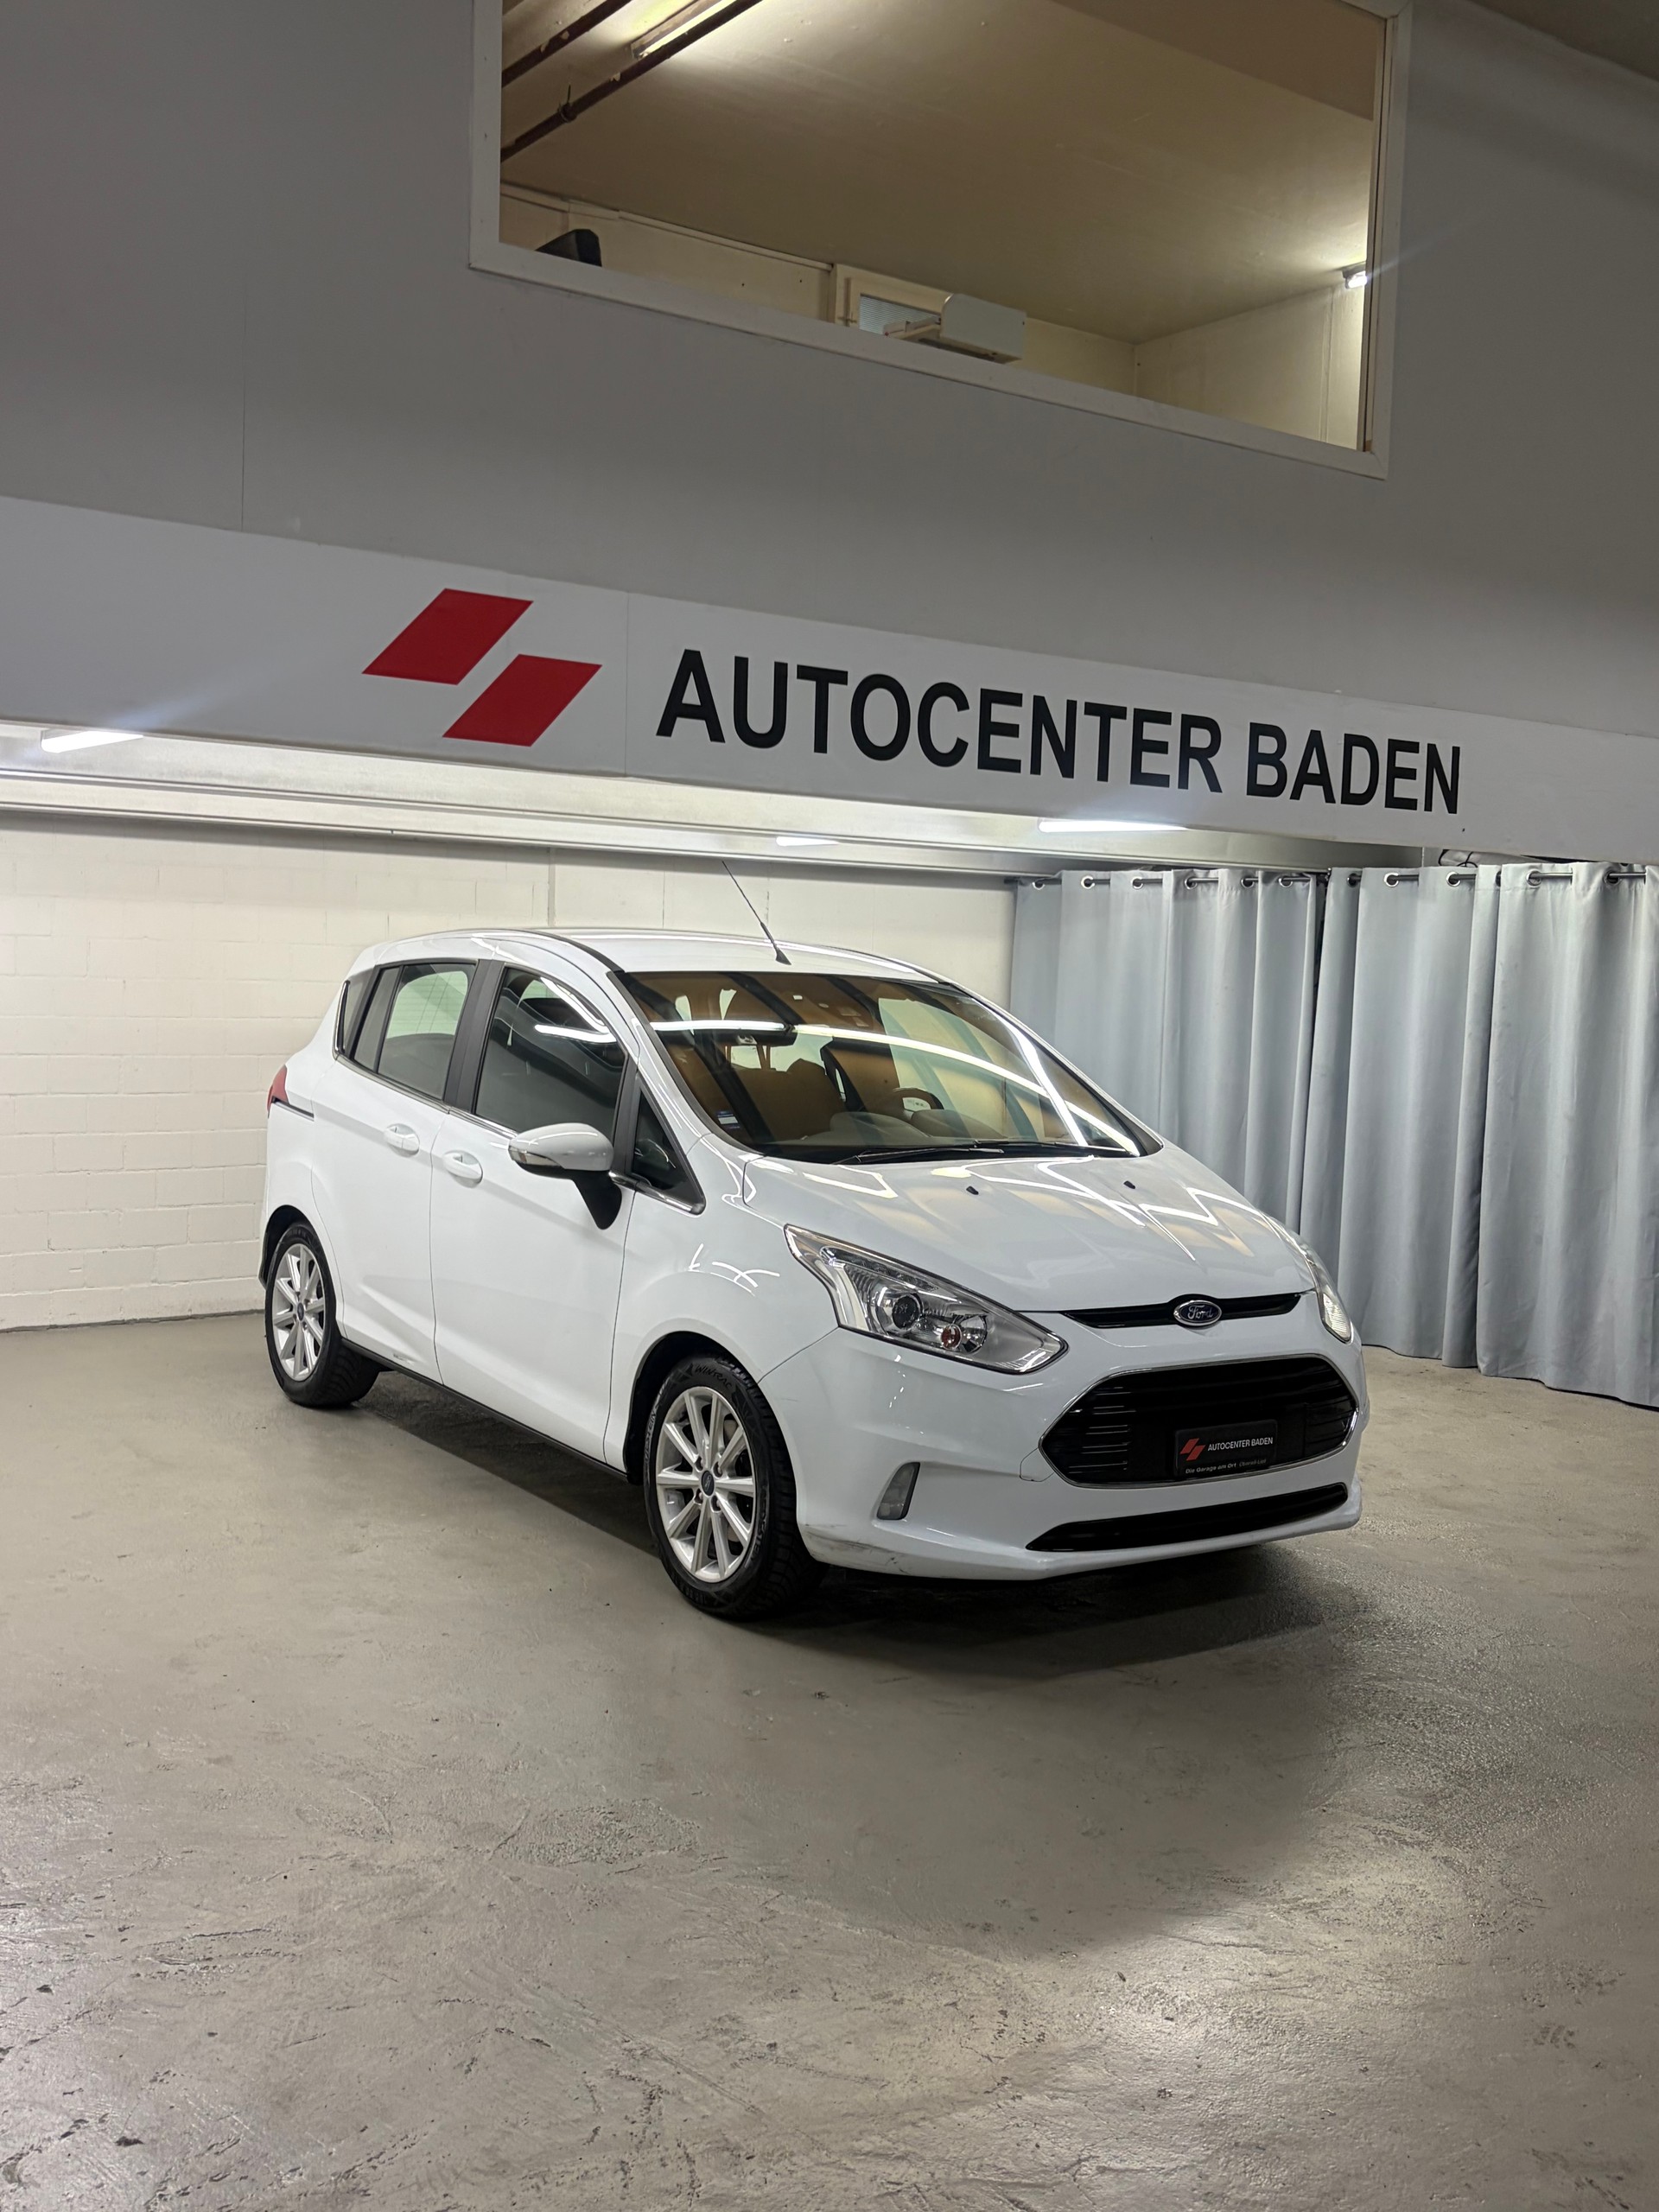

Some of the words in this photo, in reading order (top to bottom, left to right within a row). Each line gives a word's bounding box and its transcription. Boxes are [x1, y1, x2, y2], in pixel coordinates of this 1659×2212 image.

[655, 648, 1224, 794] AUTOCENTER
[1245, 721, 1462, 816] BADEN
[1187, 1305, 1213, 1319] Ford
[1208, 1440, 1249, 1451] AUTOCENTER
[1251, 1437, 1273, 1446] BADEN
